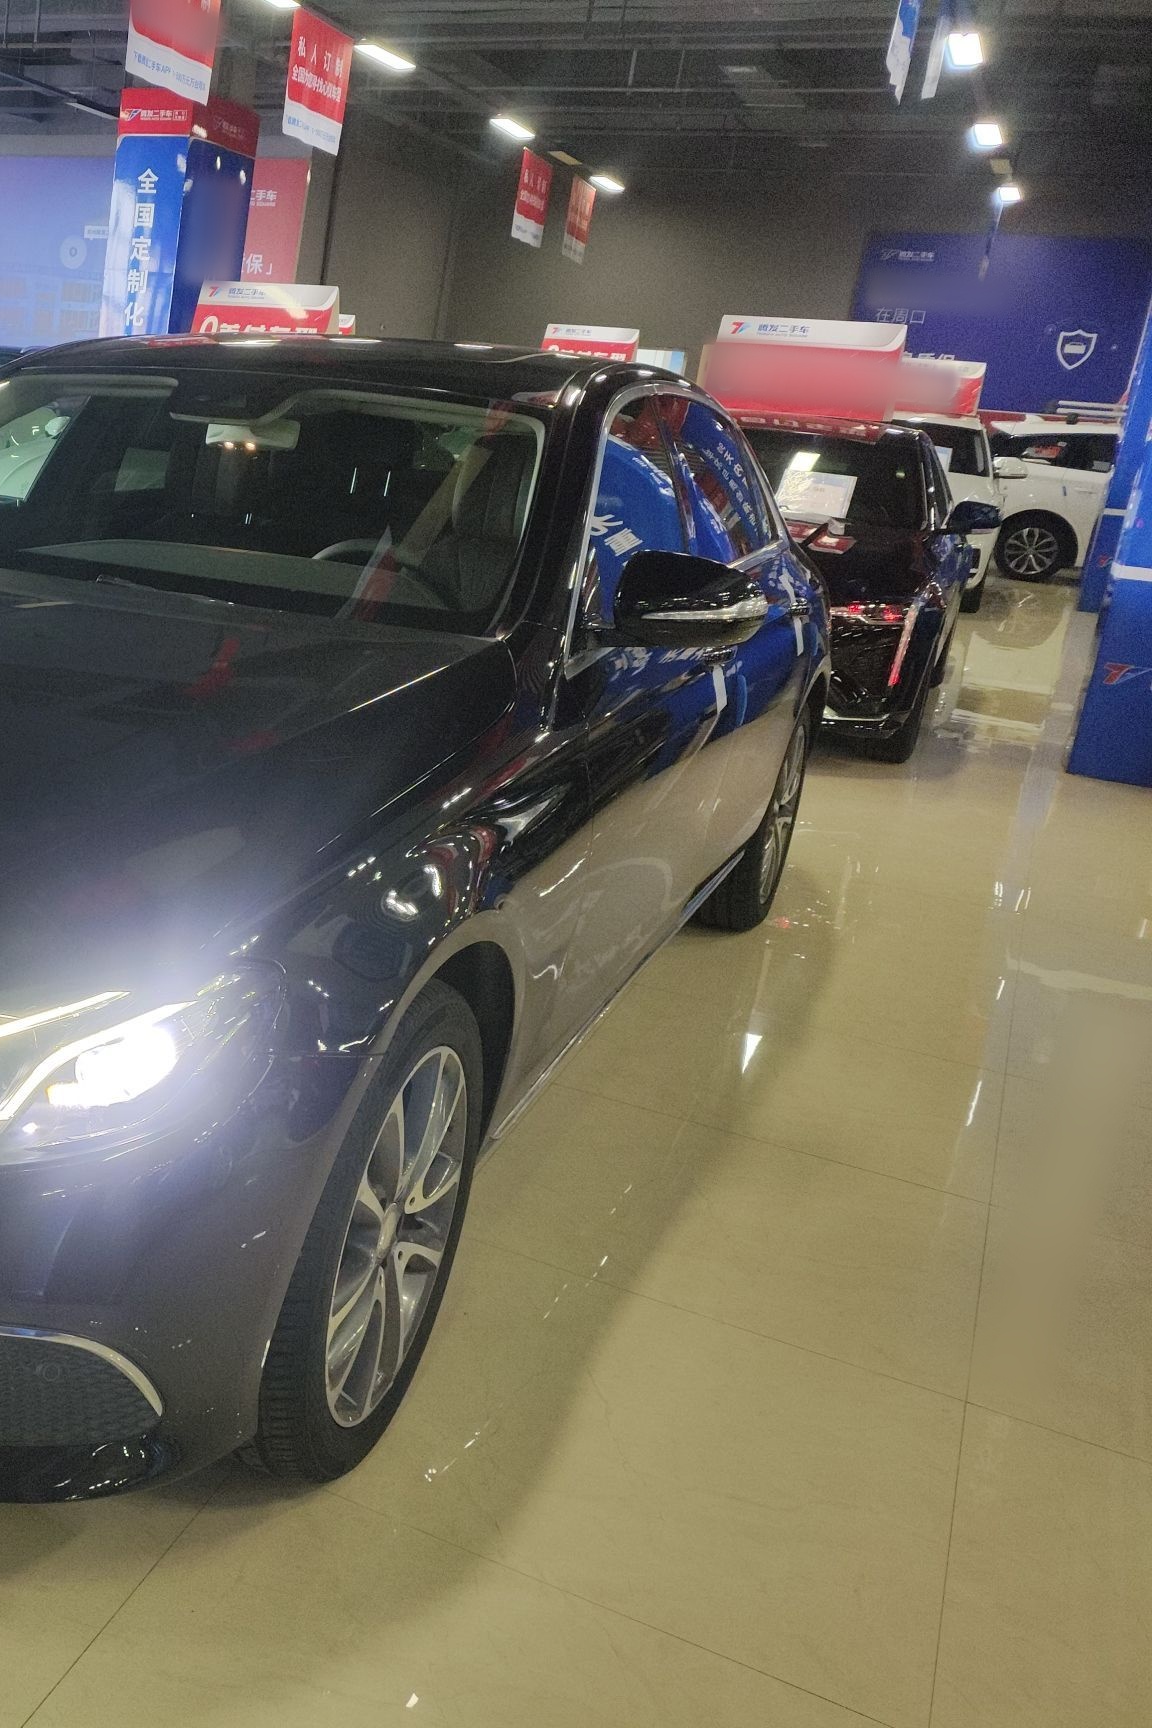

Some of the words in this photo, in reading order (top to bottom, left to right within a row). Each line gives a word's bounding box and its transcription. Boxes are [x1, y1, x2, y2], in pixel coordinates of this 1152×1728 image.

[124, 167, 159, 327] 全国定制化
[875, 307, 926, 325] 在周口
